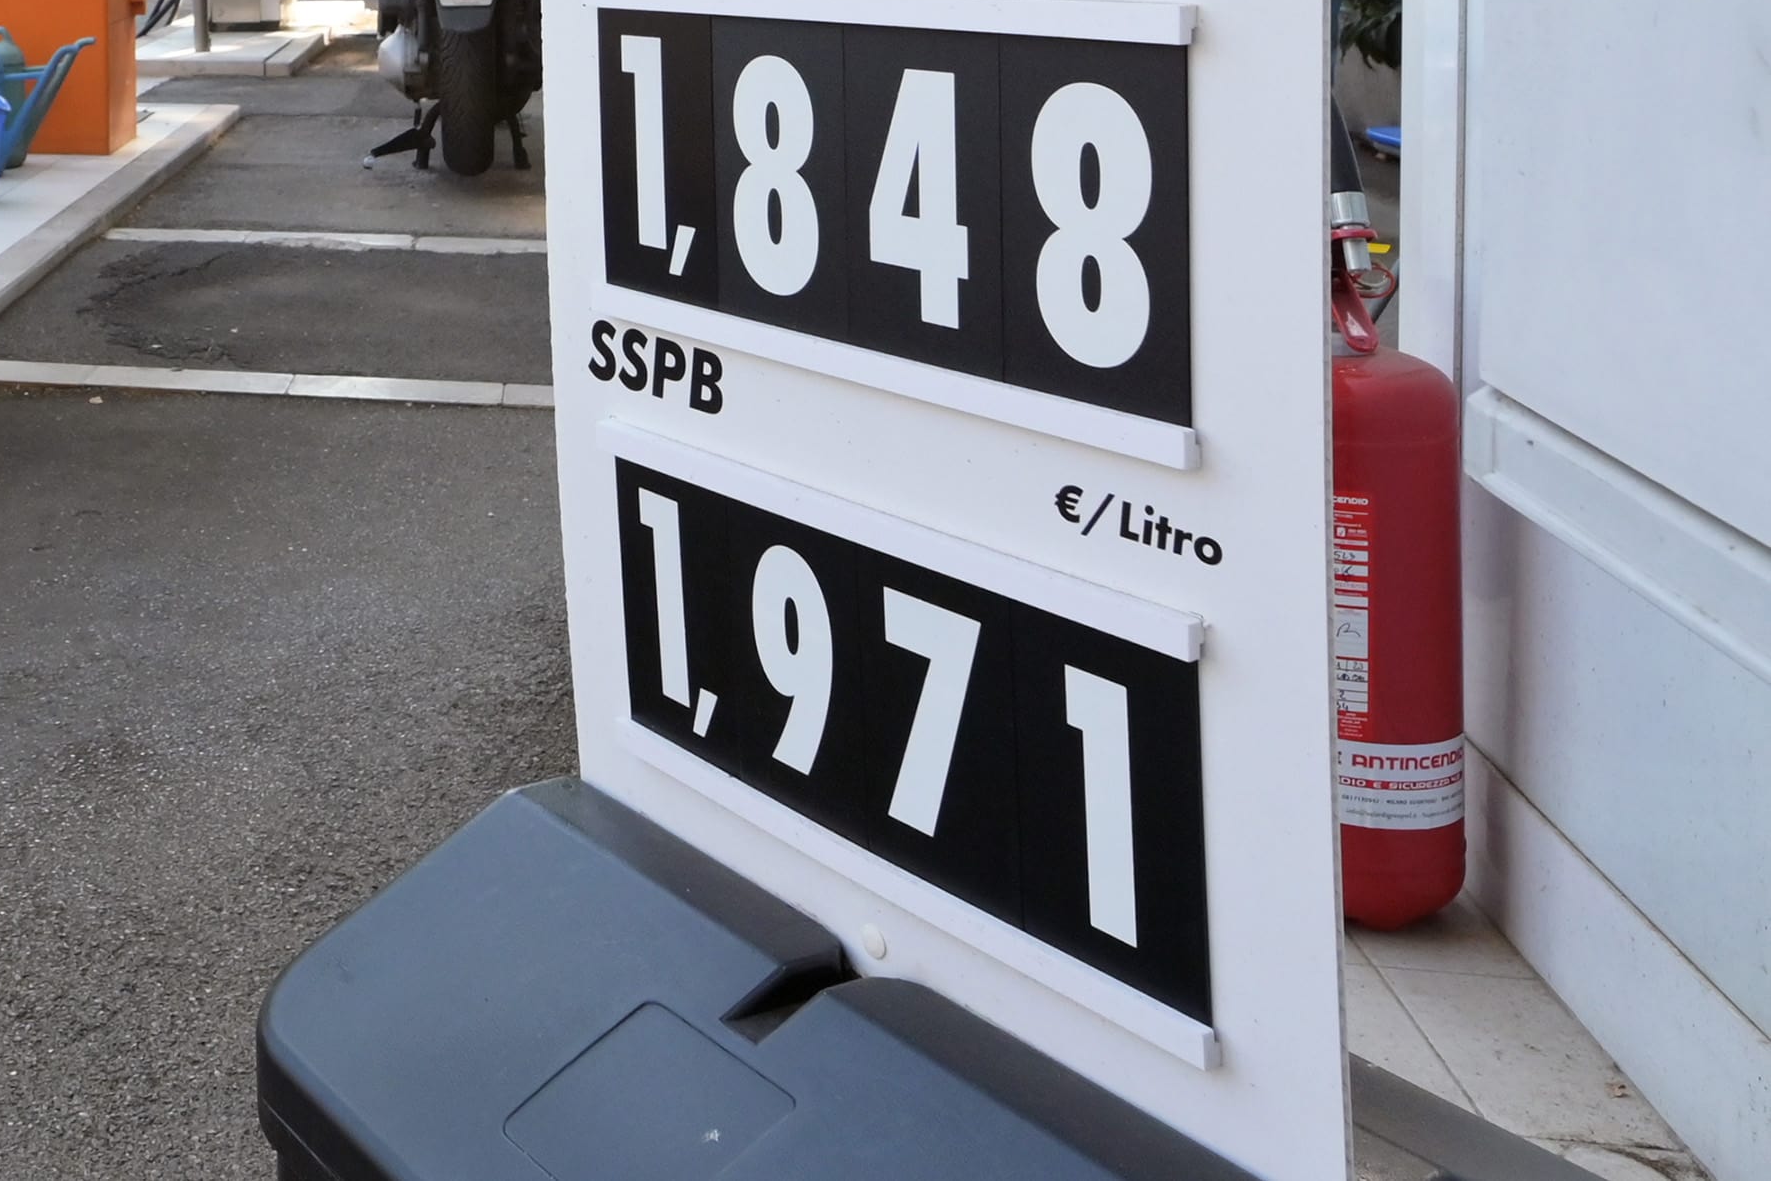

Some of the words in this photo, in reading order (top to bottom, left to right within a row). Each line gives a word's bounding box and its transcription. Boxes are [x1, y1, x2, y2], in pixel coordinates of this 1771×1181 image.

[620, 34, 1153, 369] 1,848
[588, 319, 724, 415] SSPB
[1054, 485, 1223, 566] €/Litro
[638, 487, 1138, 948] 1,971
